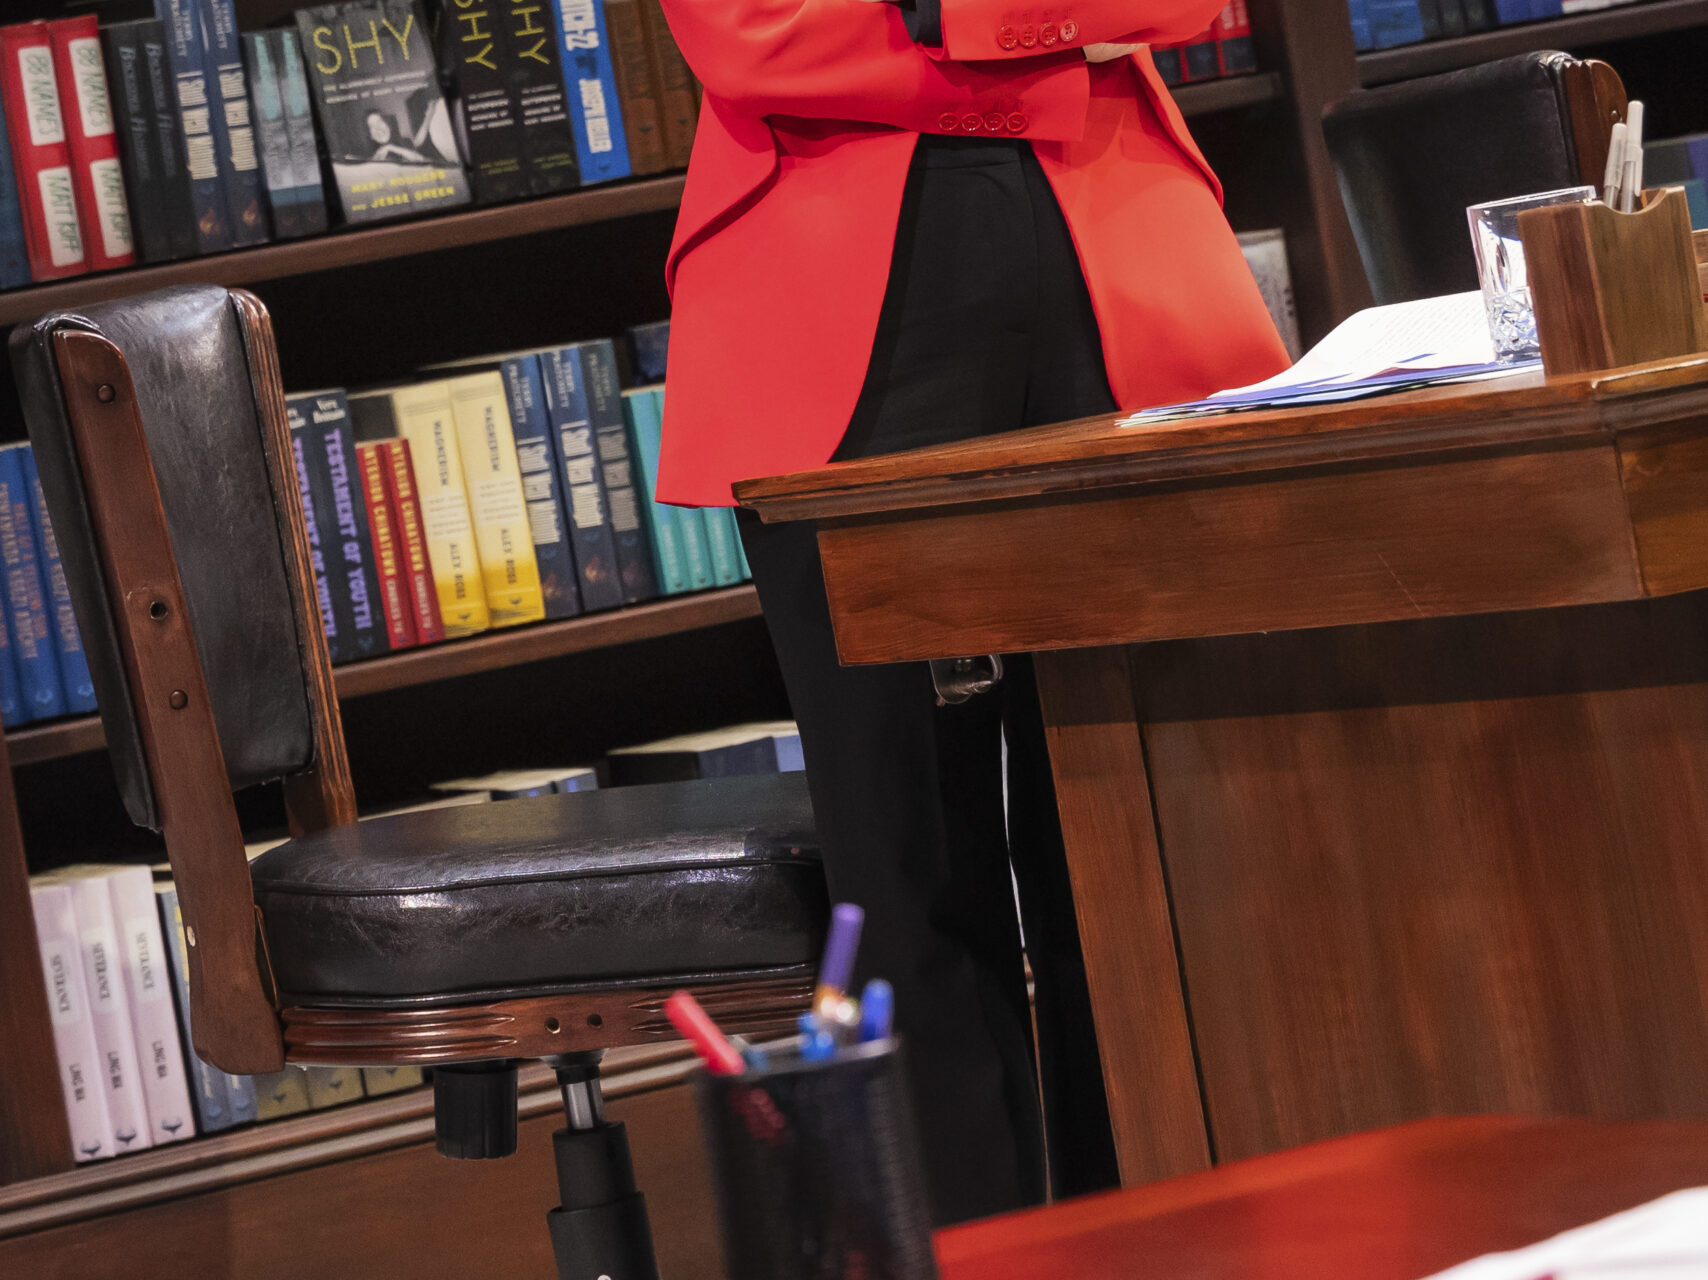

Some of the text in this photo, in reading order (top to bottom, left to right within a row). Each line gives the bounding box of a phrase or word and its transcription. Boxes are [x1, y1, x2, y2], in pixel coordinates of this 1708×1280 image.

[313, 14, 414, 75] SHY
[26, 55, 60, 136] 88 NAMES
[77, 44, 111, 129] 88 NAMES
[46, 175, 75, 216] MATT
[100, 168, 124, 210] MATT
[434, 421, 449, 486] WAGNERISM
[484, 406, 500, 472] WAGNERISM
[324, 428, 372, 630] TESTAMENT OF YOUTH
[374, 504, 397, 576] CHINATOWN
[402, 501, 424, 572] CHINATOWN
[501, 529, 516, 584] ALEX ROSS
[450, 543, 466, 600] ALEX ROSS
